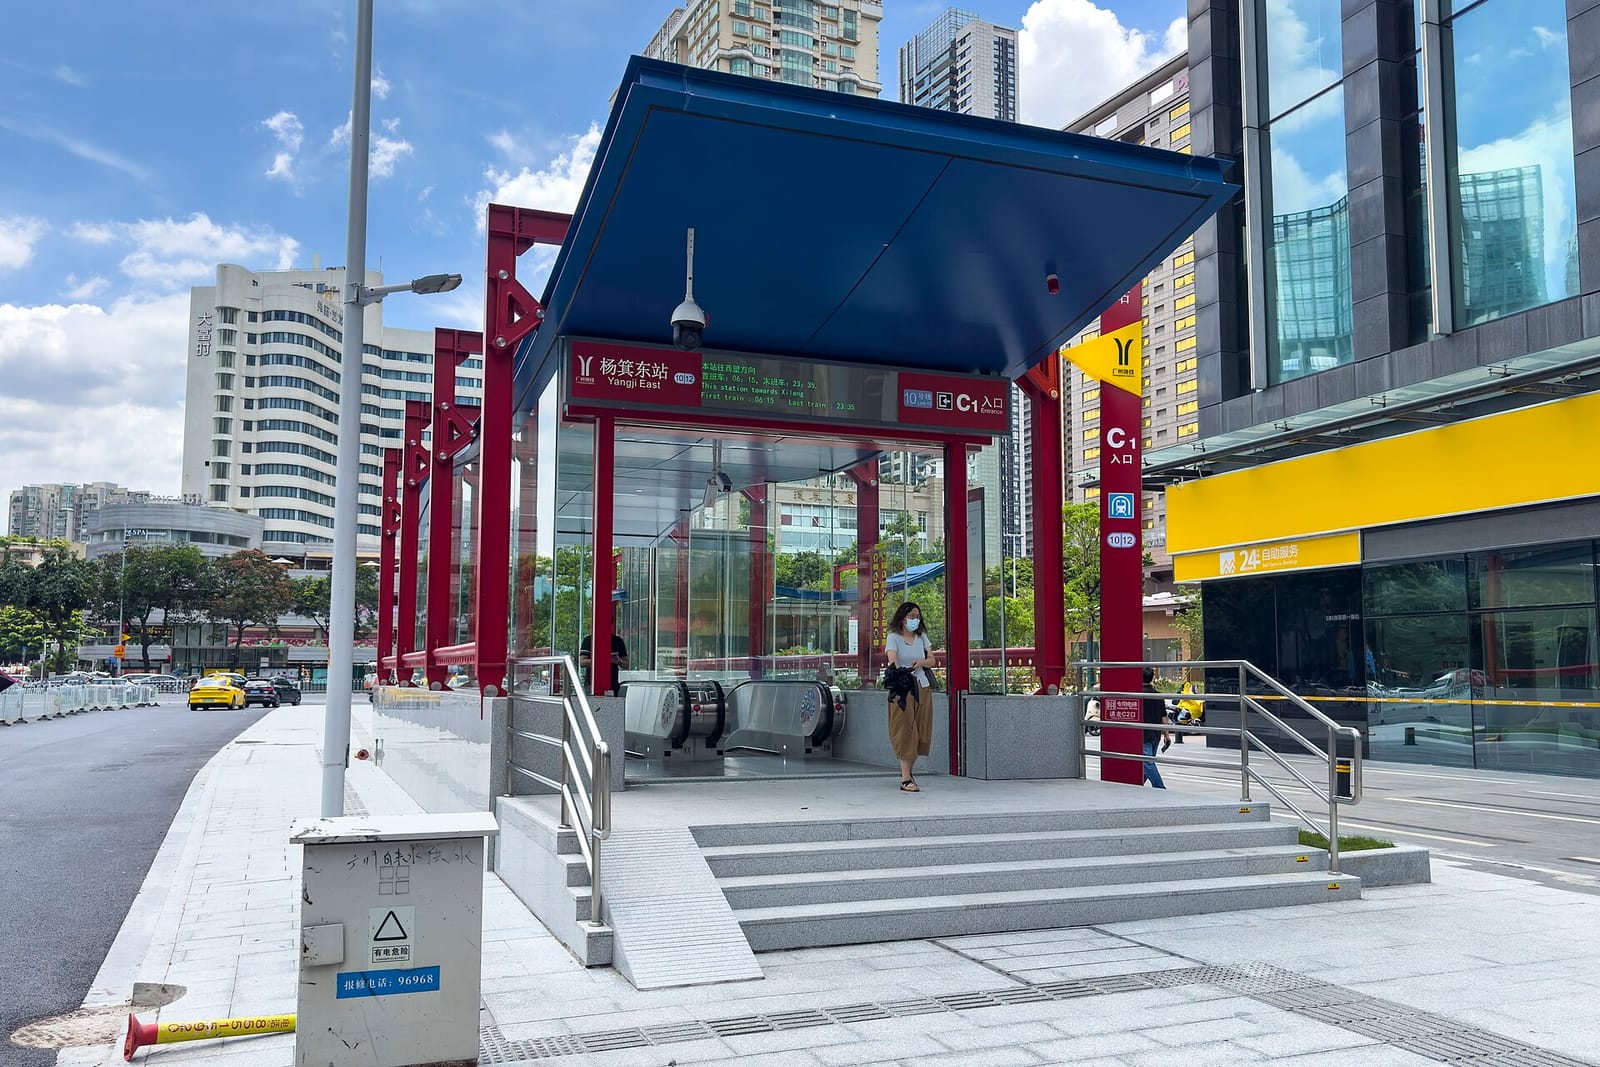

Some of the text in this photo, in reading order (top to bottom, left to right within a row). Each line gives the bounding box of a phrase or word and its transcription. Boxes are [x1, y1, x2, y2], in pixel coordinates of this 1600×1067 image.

[600, 357, 669, 380] 杨箕东站
[607, 376, 662, 390] Yangji East
[675, 373, 694, 383] 10 12
[720, 384, 748, 393] station
[701, 391, 721, 400] First
[904, 391, 917, 405] 10
[981, 395, 1003, 409] 入口
[956, 393, 978, 413] C1
[1110, 454, 1133, 465] 入口
[1110, 536, 1133, 544] 10 12
[1262, 544, 1299, 561] 自助服务
[1240, 549, 1260, 571] 24
[374, 947, 409, 957] 有电危险
[398, 974, 434, 986] 96968
